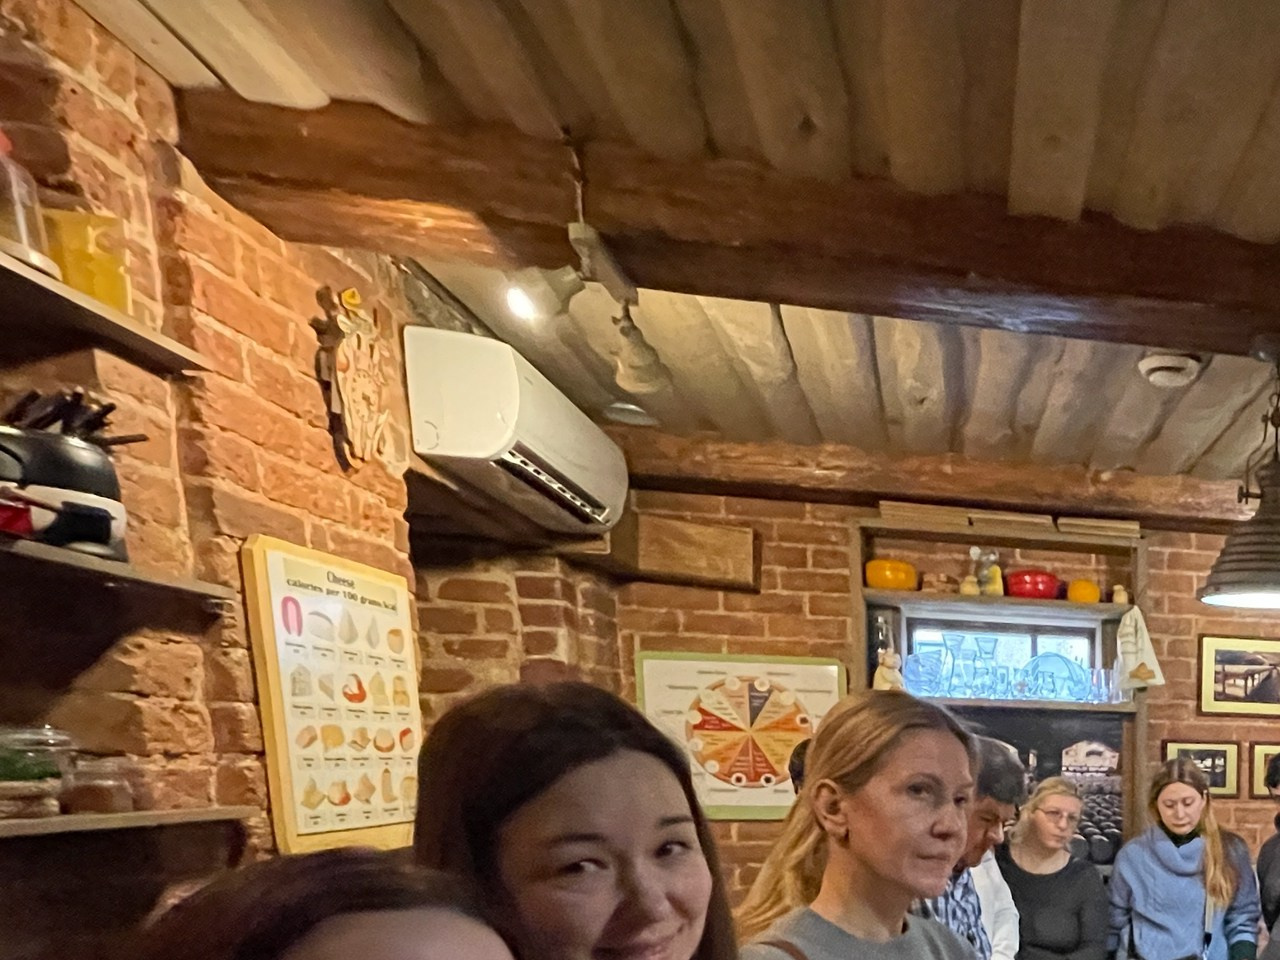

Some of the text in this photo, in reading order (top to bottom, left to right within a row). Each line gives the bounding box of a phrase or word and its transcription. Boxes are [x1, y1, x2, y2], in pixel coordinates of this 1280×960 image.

[326, 570, 355, 588] Cheese
[286, 578, 323, 593] calories
[326, 587, 340, 596] per
[342, 591, 358, 601] 100
